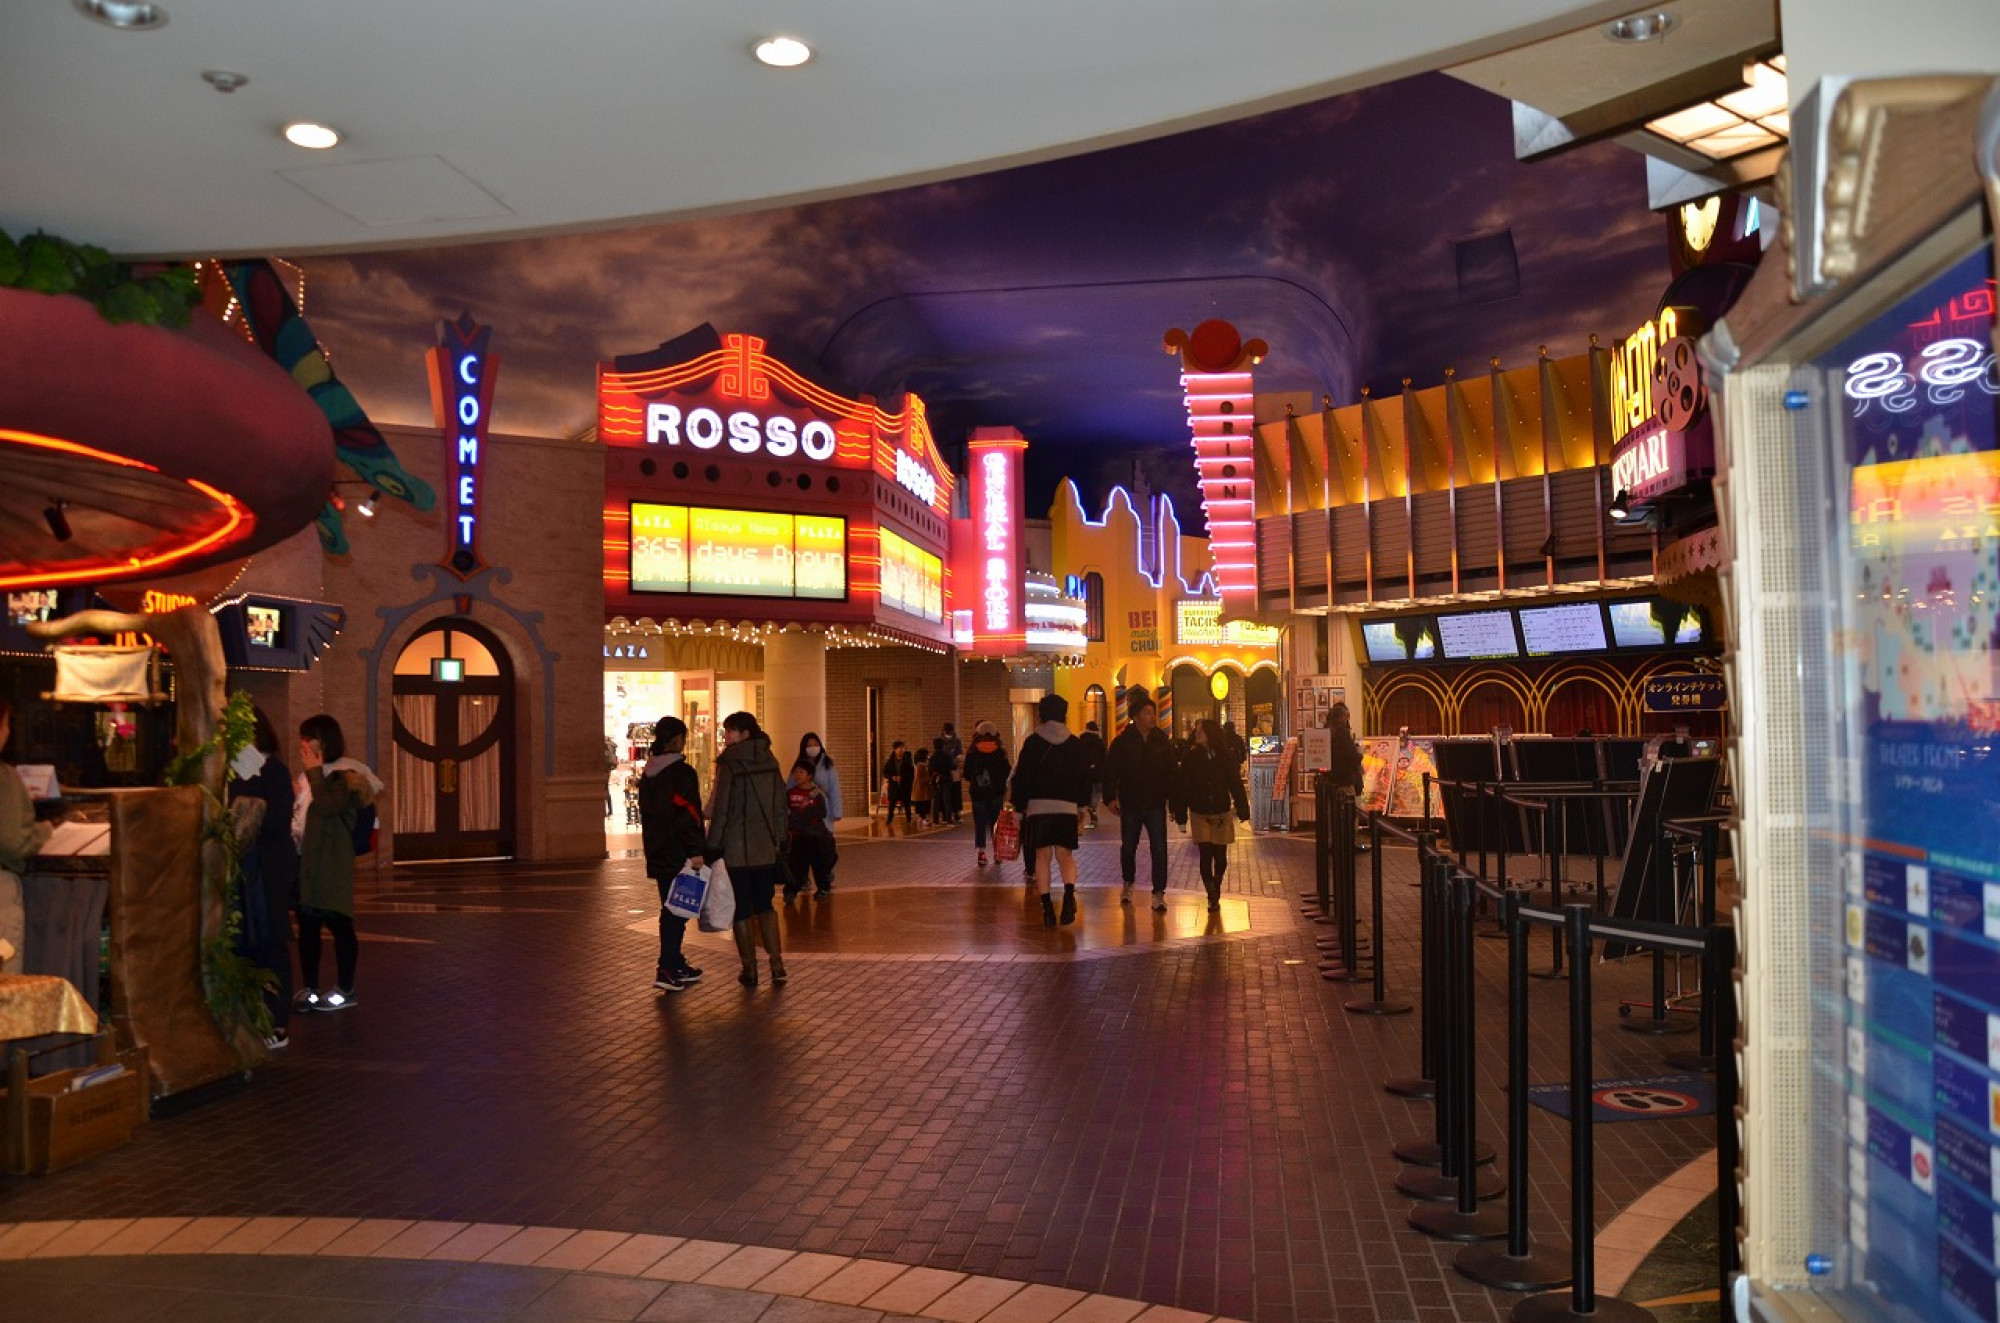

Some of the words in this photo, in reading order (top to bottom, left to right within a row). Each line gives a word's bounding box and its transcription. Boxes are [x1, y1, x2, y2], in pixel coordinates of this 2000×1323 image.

[459, 355, 479, 544] COMET
[646, 402, 836, 460] ROSSO
[1220, 400, 1237, 499] ORION
[800, 525, 842, 539] PLAZA
[983, 453, 1008, 551] GENERAL
[633, 535, 682, 561] 365
[697, 540, 760, 563] days
[986, 558, 1010, 630] STORE
